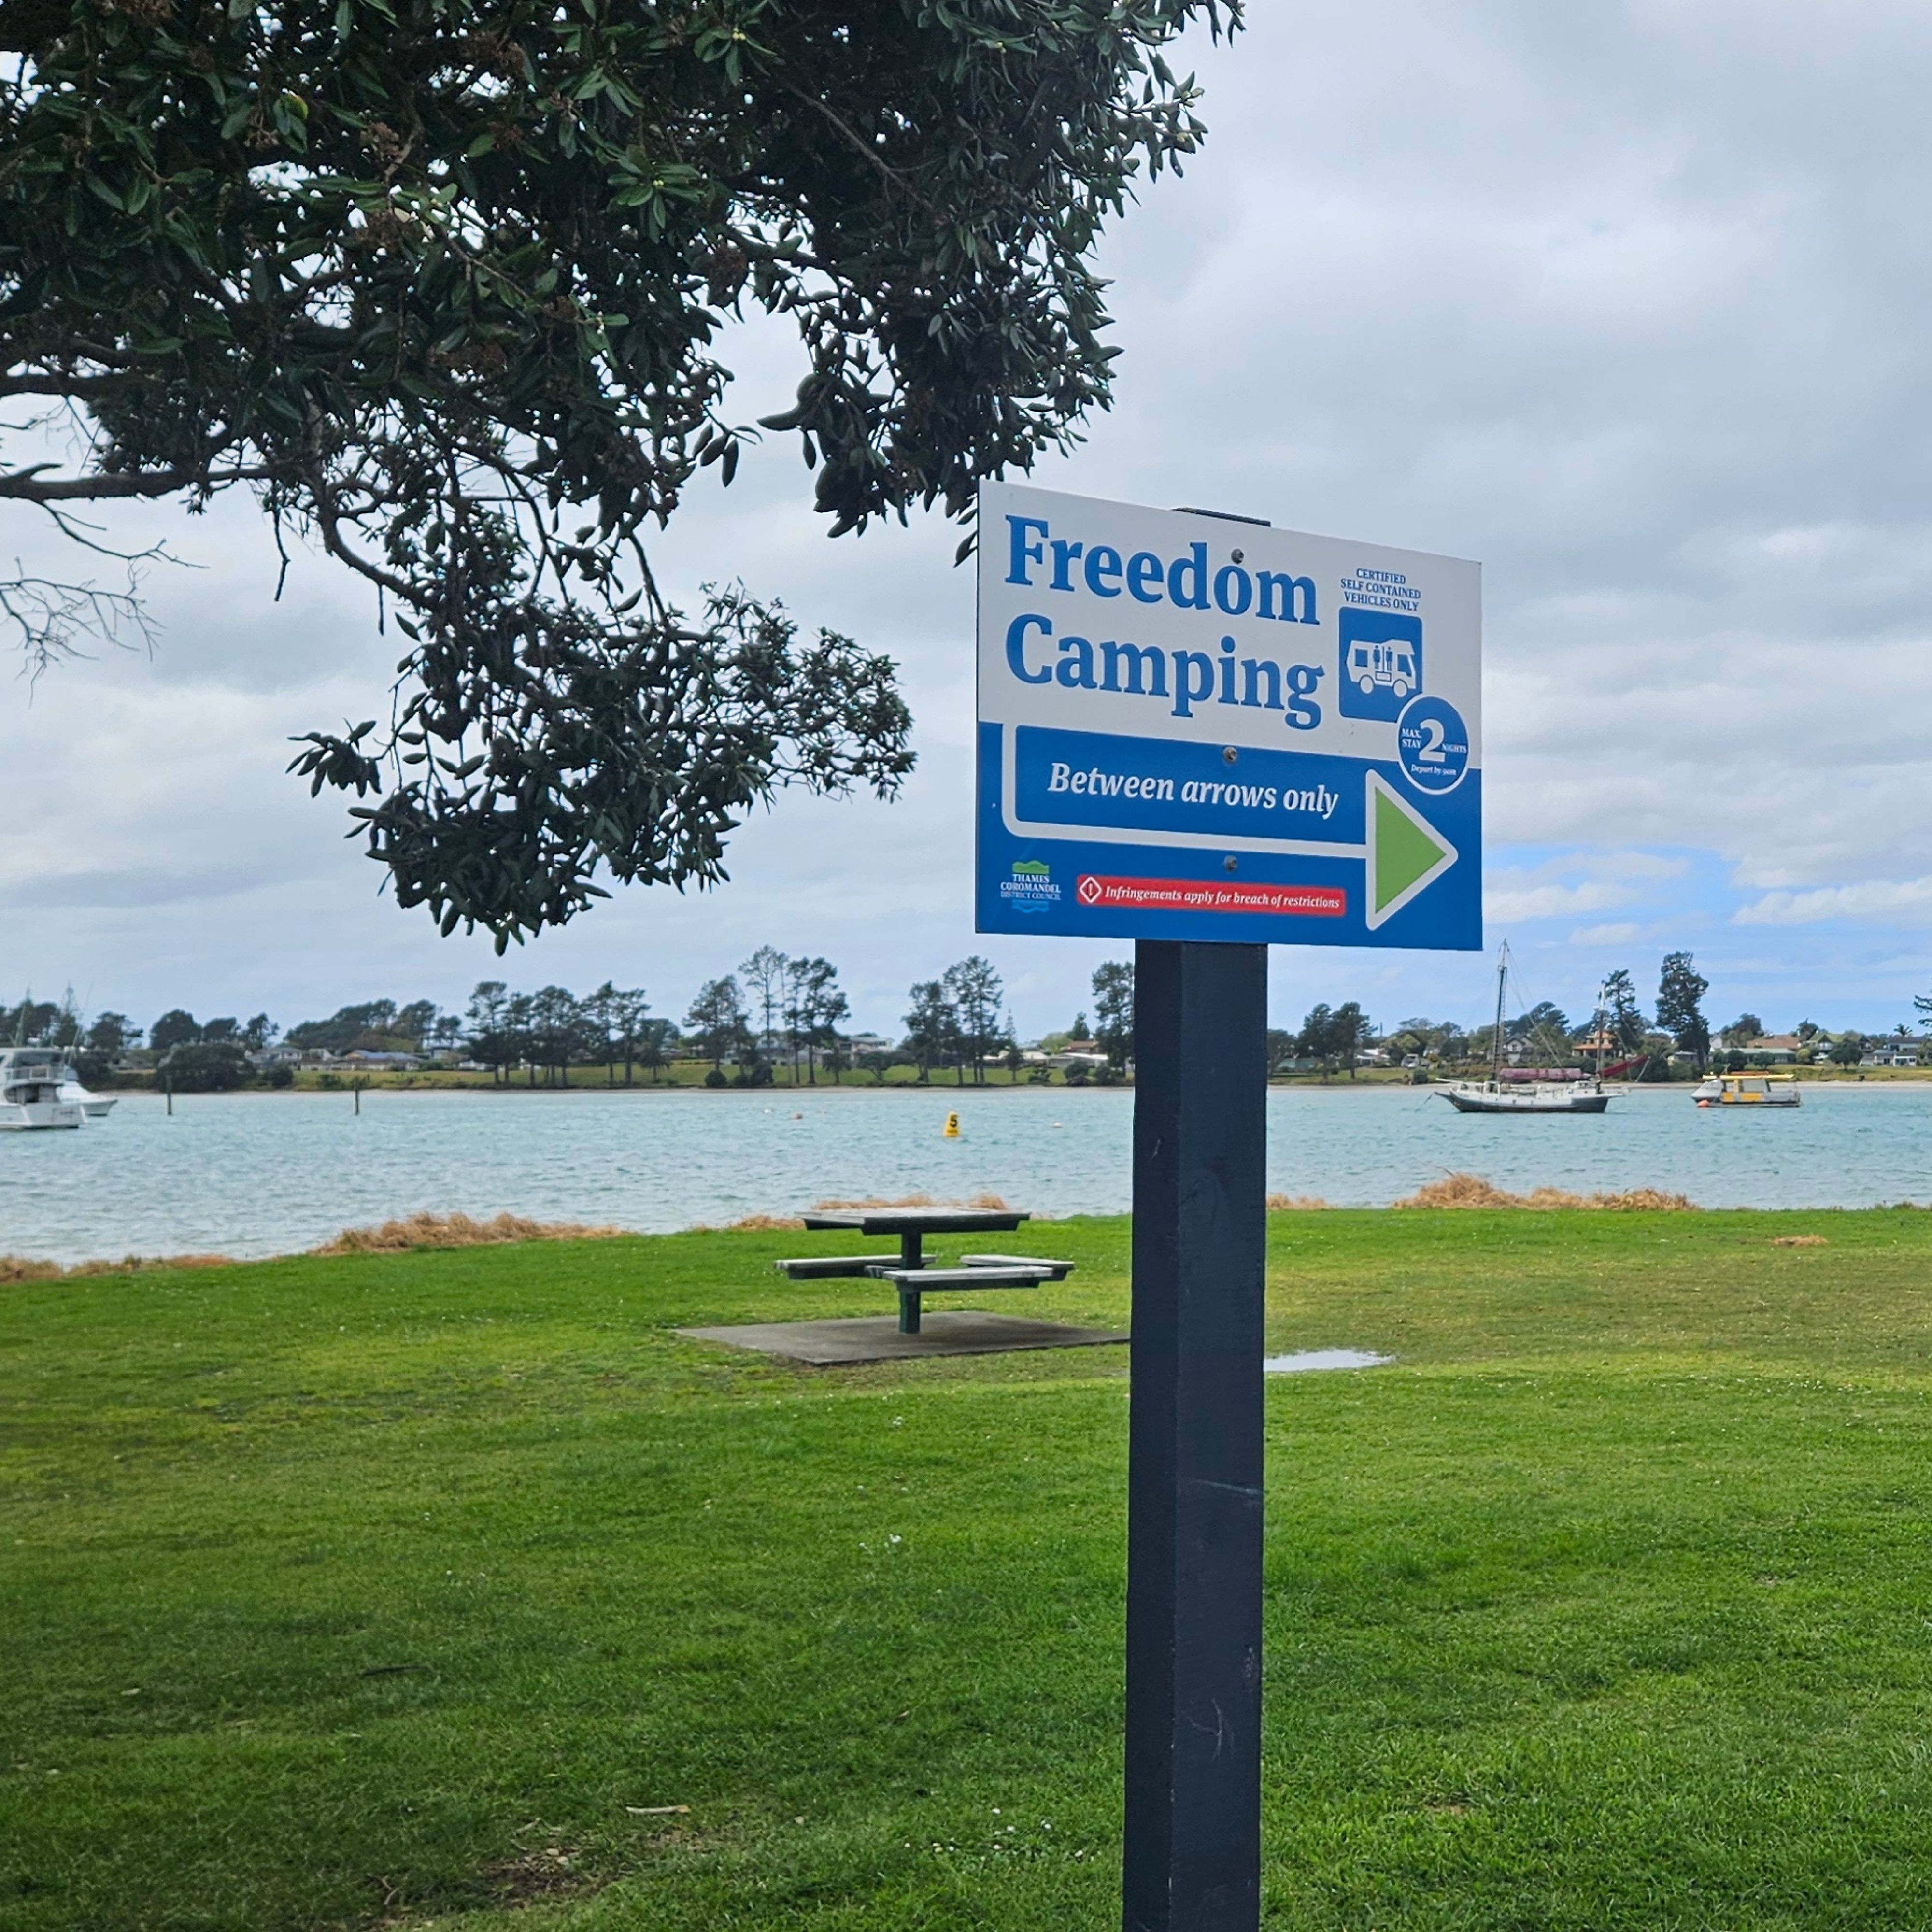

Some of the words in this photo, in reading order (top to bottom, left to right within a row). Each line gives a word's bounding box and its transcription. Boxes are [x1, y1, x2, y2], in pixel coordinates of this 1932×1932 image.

[1005, 514, 1320, 625] Freedom
[1356, 568, 1406, 584] CERTIFIED
[1341, 578, 1364, 592] SELF
[1366, 582, 1421, 599] CONTAINED
[1344, 591, 1391, 607] VEHICLES
[1393, 598, 1419, 611] ONLY
[1005, 613, 1324, 730] Camping
[1402, 739, 1421, 749] STAY
[1419, 719, 1445, 762] 2
[1442, 744, 1467, 753] NIGHTS
[1434, 766, 1441, 776] by
[1047, 762, 1174, 801] Between
[1180, 779, 1277, 810] arrows
[1282, 784, 1339, 821] only
[1012, 873, 1050, 883] THAMES
[1000, 882, 1061, 893] COROMANDEL
[1031, 892, 1061, 901] COUNCIL
[1105, 886, 1182, 902] Infringements
[1184, 891, 1214, 905] apply
[1214, 891, 1231, 905] for
[1233, 892, 1269, 905] breach
[1270, 895, 1282, 908] of
[1283, 895, 1340, 909] restrictions
[950, 1114, 958, 1128] 5
